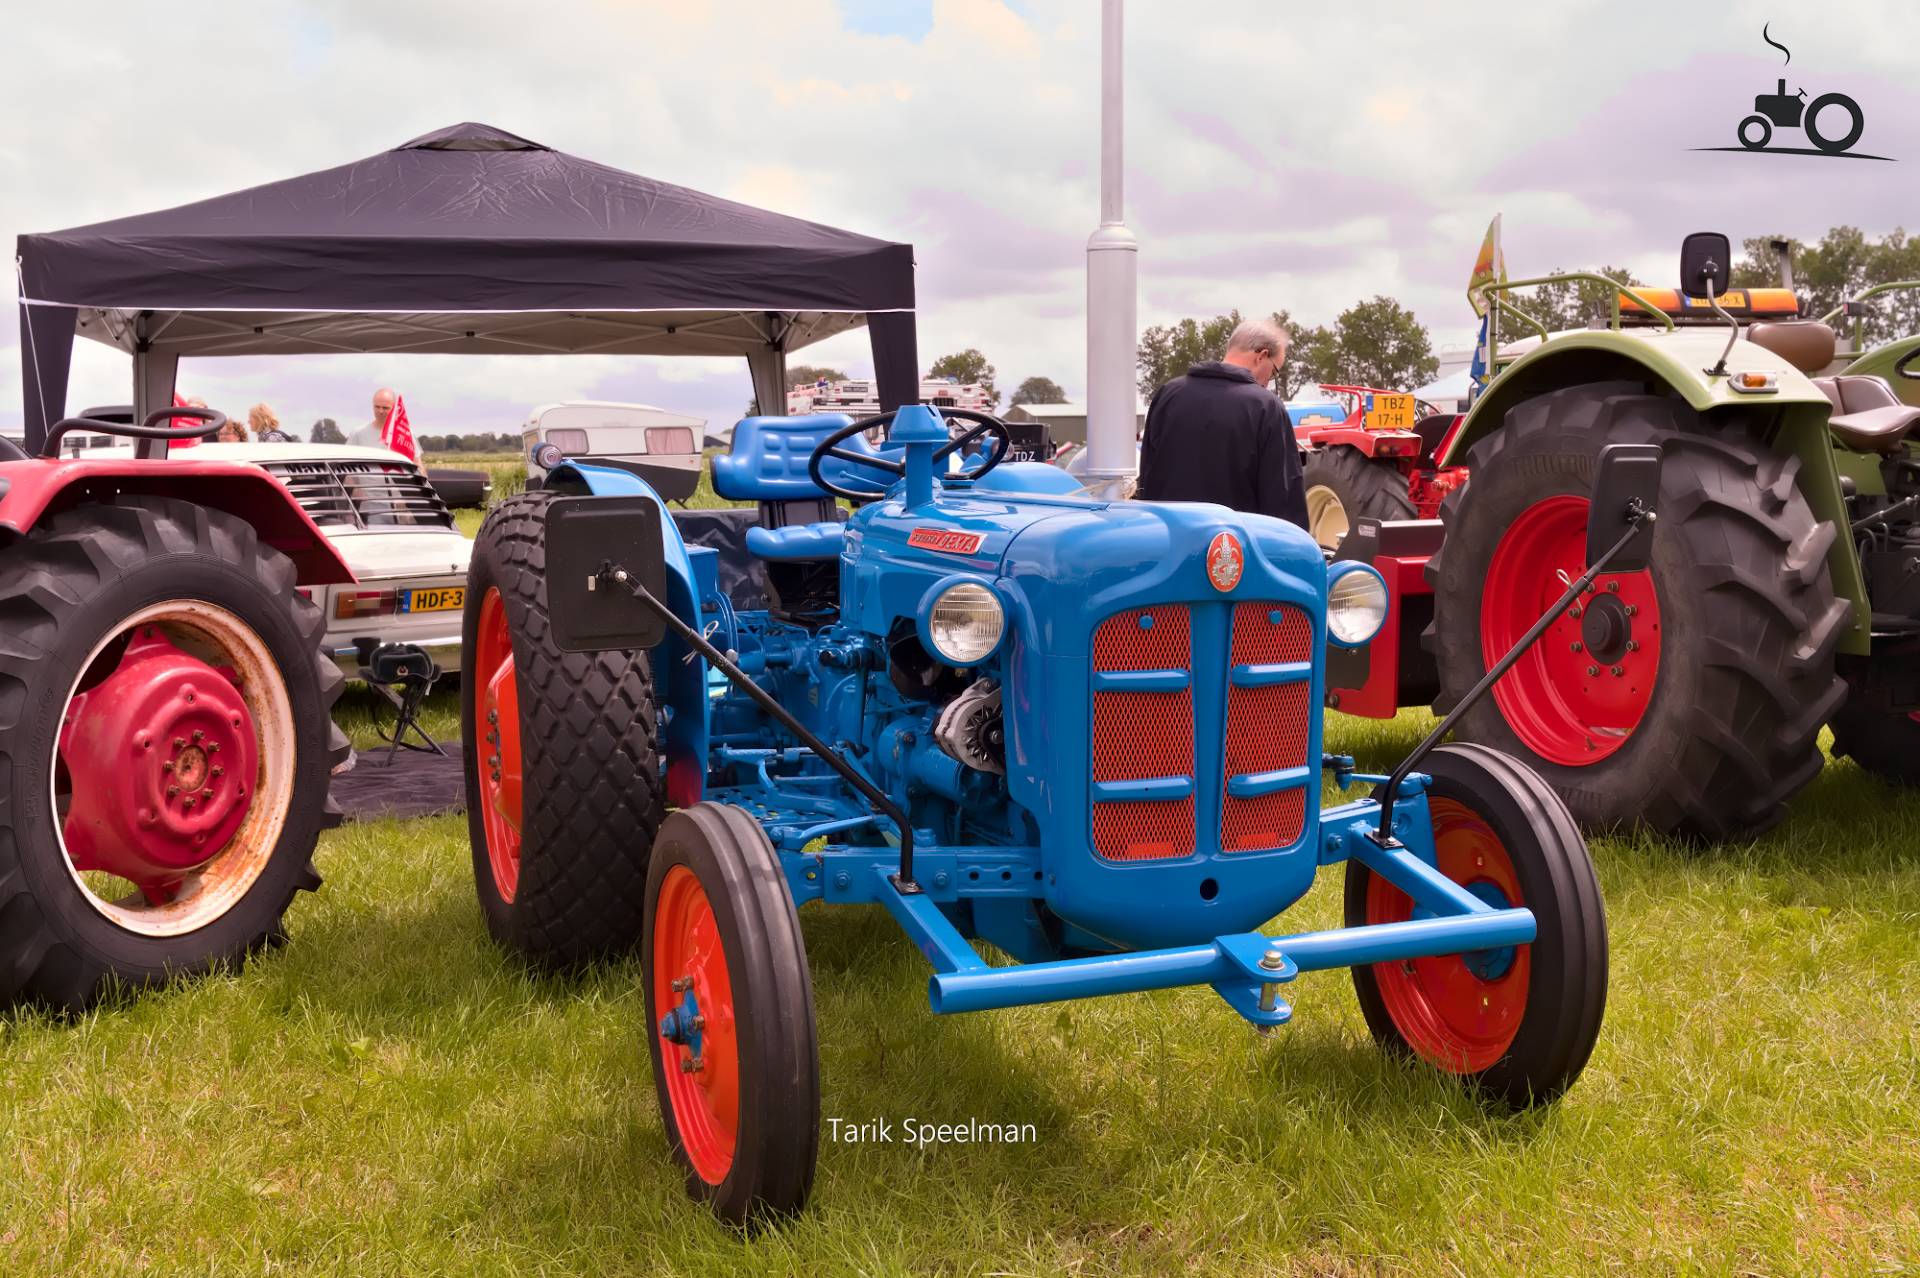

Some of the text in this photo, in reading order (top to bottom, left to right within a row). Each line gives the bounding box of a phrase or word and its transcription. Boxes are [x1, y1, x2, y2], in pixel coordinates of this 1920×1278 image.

[1382, 397, 1406, 409] TBZ
[1378, 413, 1403, 426] 17-H
[1014, 451, 1036, 462] TDZ
[416, 591, 463, 609] HDF-3
